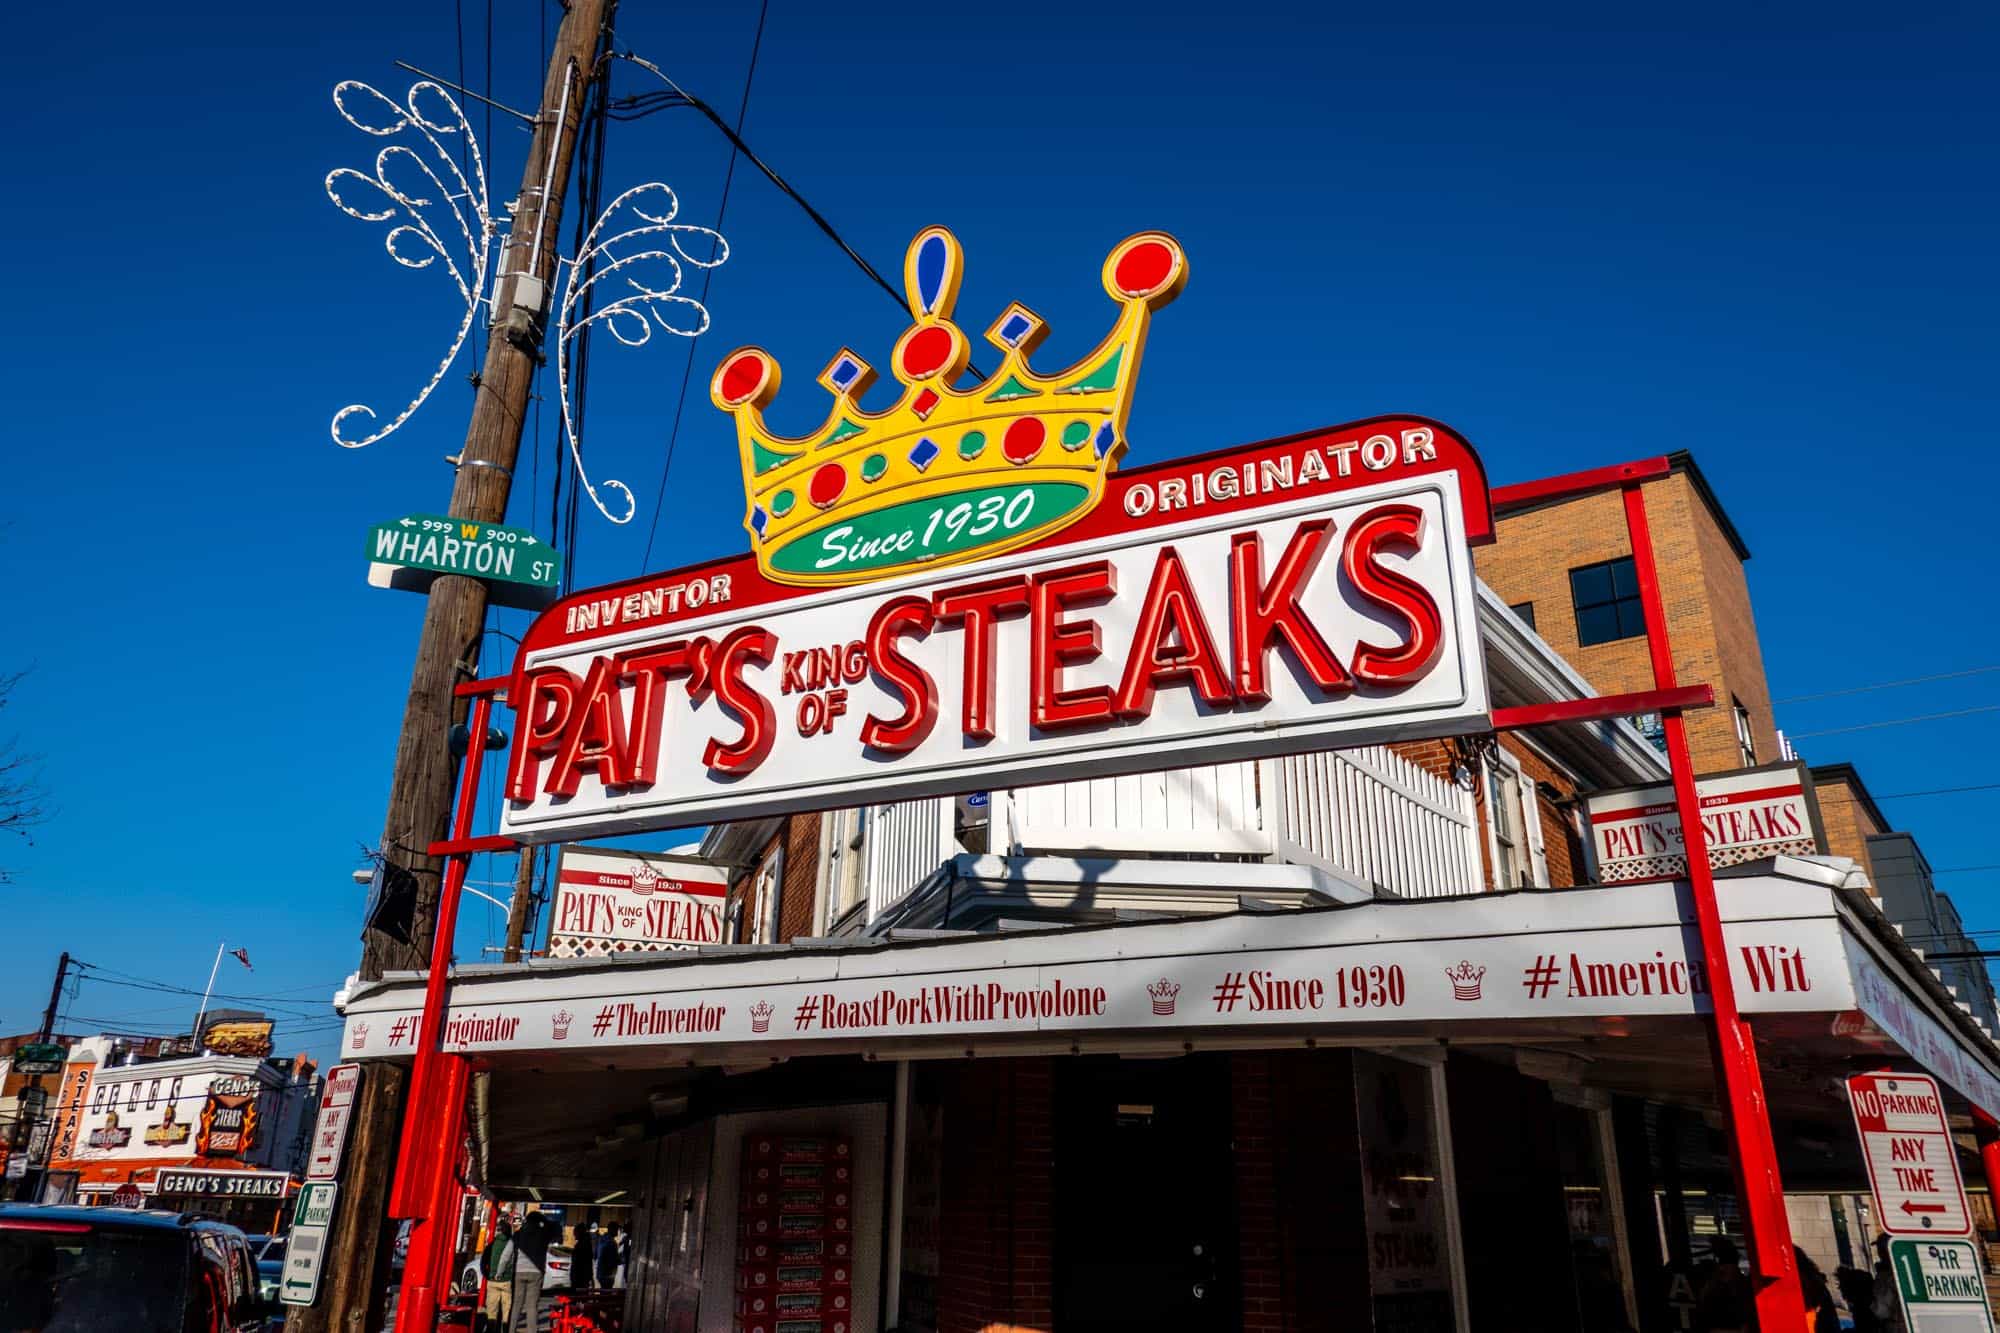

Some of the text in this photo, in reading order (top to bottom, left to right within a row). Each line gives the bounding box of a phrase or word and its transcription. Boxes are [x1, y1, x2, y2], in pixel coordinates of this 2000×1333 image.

[1124, 427, 1437, 518] ORIGINATOR
[421, 519, 517, 544] 999 W 900
[815, 488, 1035, 569] Since 1930
[375, 528, 554, 582] WHARTON ST
[566, 573, 732, 635] INVENTOR
[505, 504, 1446, 805] PAT'S KING OF STEAKS
[1601, 821, 1668, 861] PAT'S
[1700, 803, 1804, 848] STEAKS
[599, 875, 683, 891] Since 1930
[559, 892, 721, 944] PAT'S KING OF STEAKS
[794, 978, 1107, 1032] #RoastPorkWithProvolone
[1212, 964, 1406, 1013] #Since 1930
[592, 1000, 727, 1038] #TheInventor
[59, 1070, 89, 1158] STEAKS
[1852, 1089, 1938, 1119] NO PARKING
[1890, 1136, 1927, 1162] ANY
[163, 1175, 283, 1196] GENO'S STEAKS
[1892, 1167, 1940, 1193] TIME
[1901, 1248, 1961, 1297] 1 HR
[1926, 1275, 1980, 1298] PARKING
